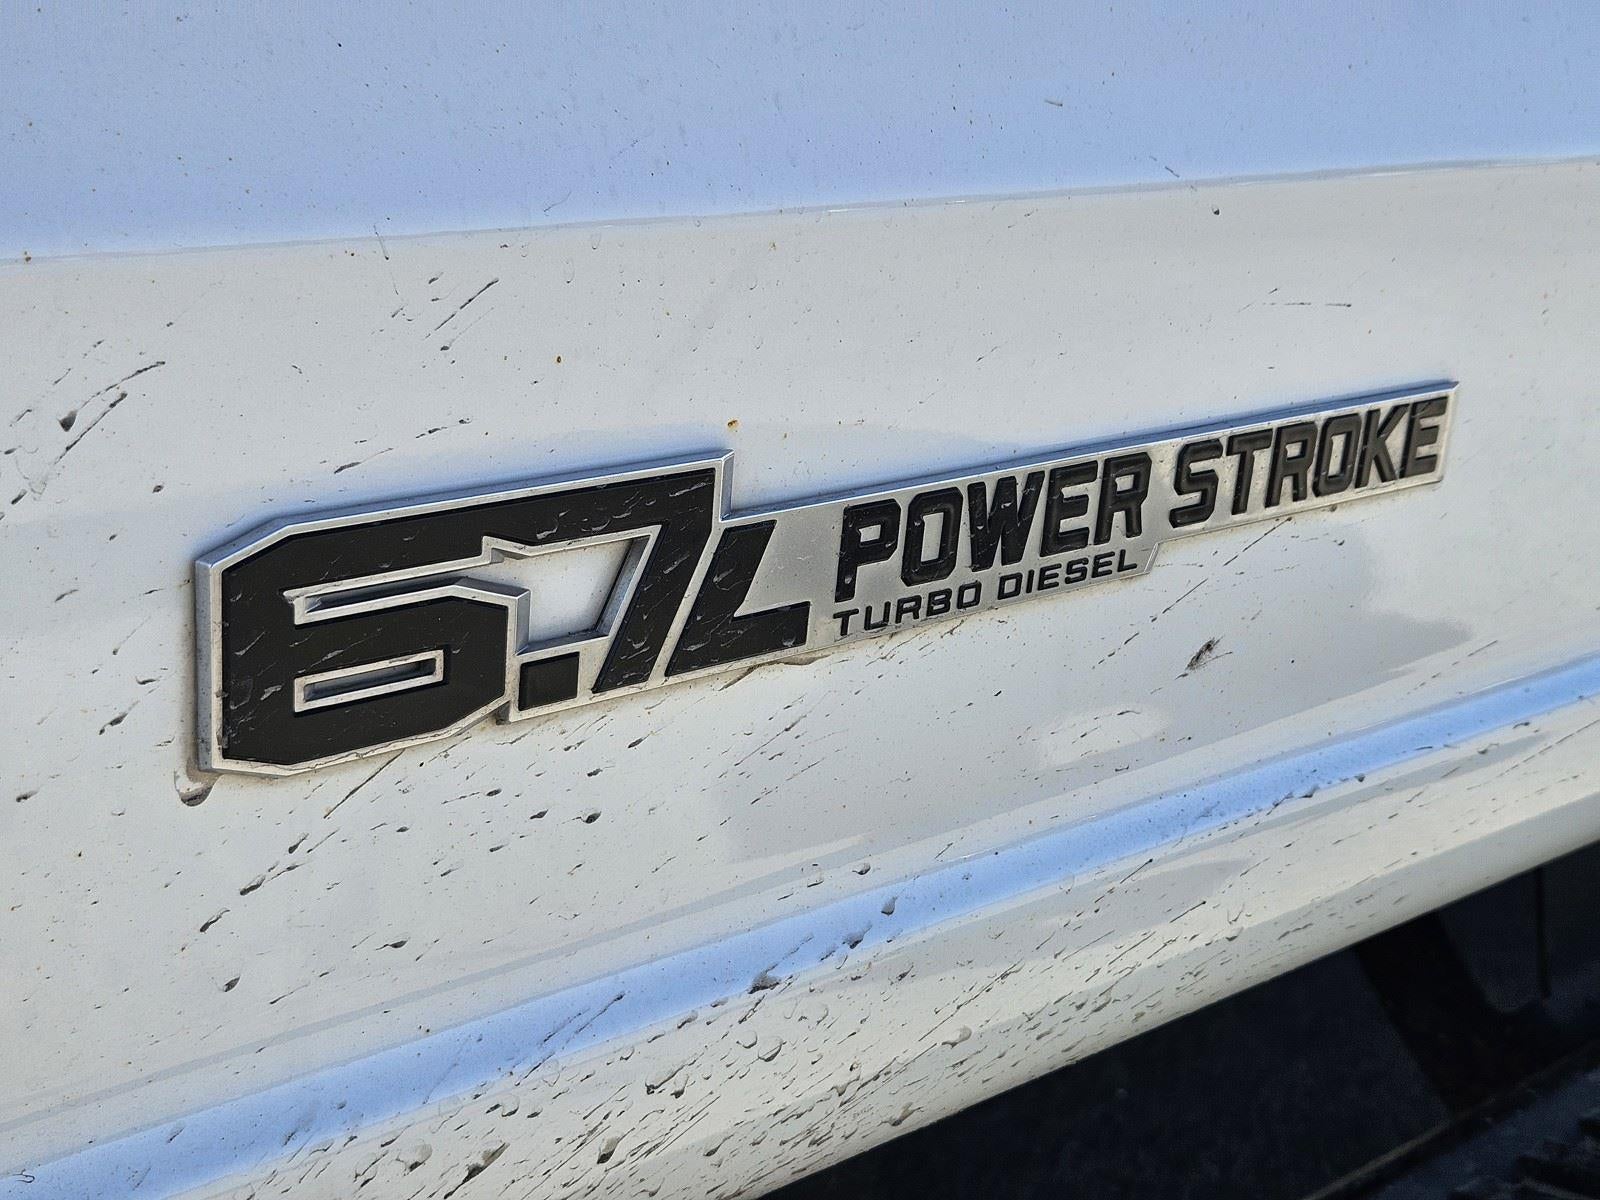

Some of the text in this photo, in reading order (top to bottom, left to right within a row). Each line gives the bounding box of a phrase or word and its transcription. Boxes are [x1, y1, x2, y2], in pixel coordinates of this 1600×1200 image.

[221, 396, 1449, 765] 6.7L POWER STROKE
[833, 549, 1138, 637] TURBO DIESEL
